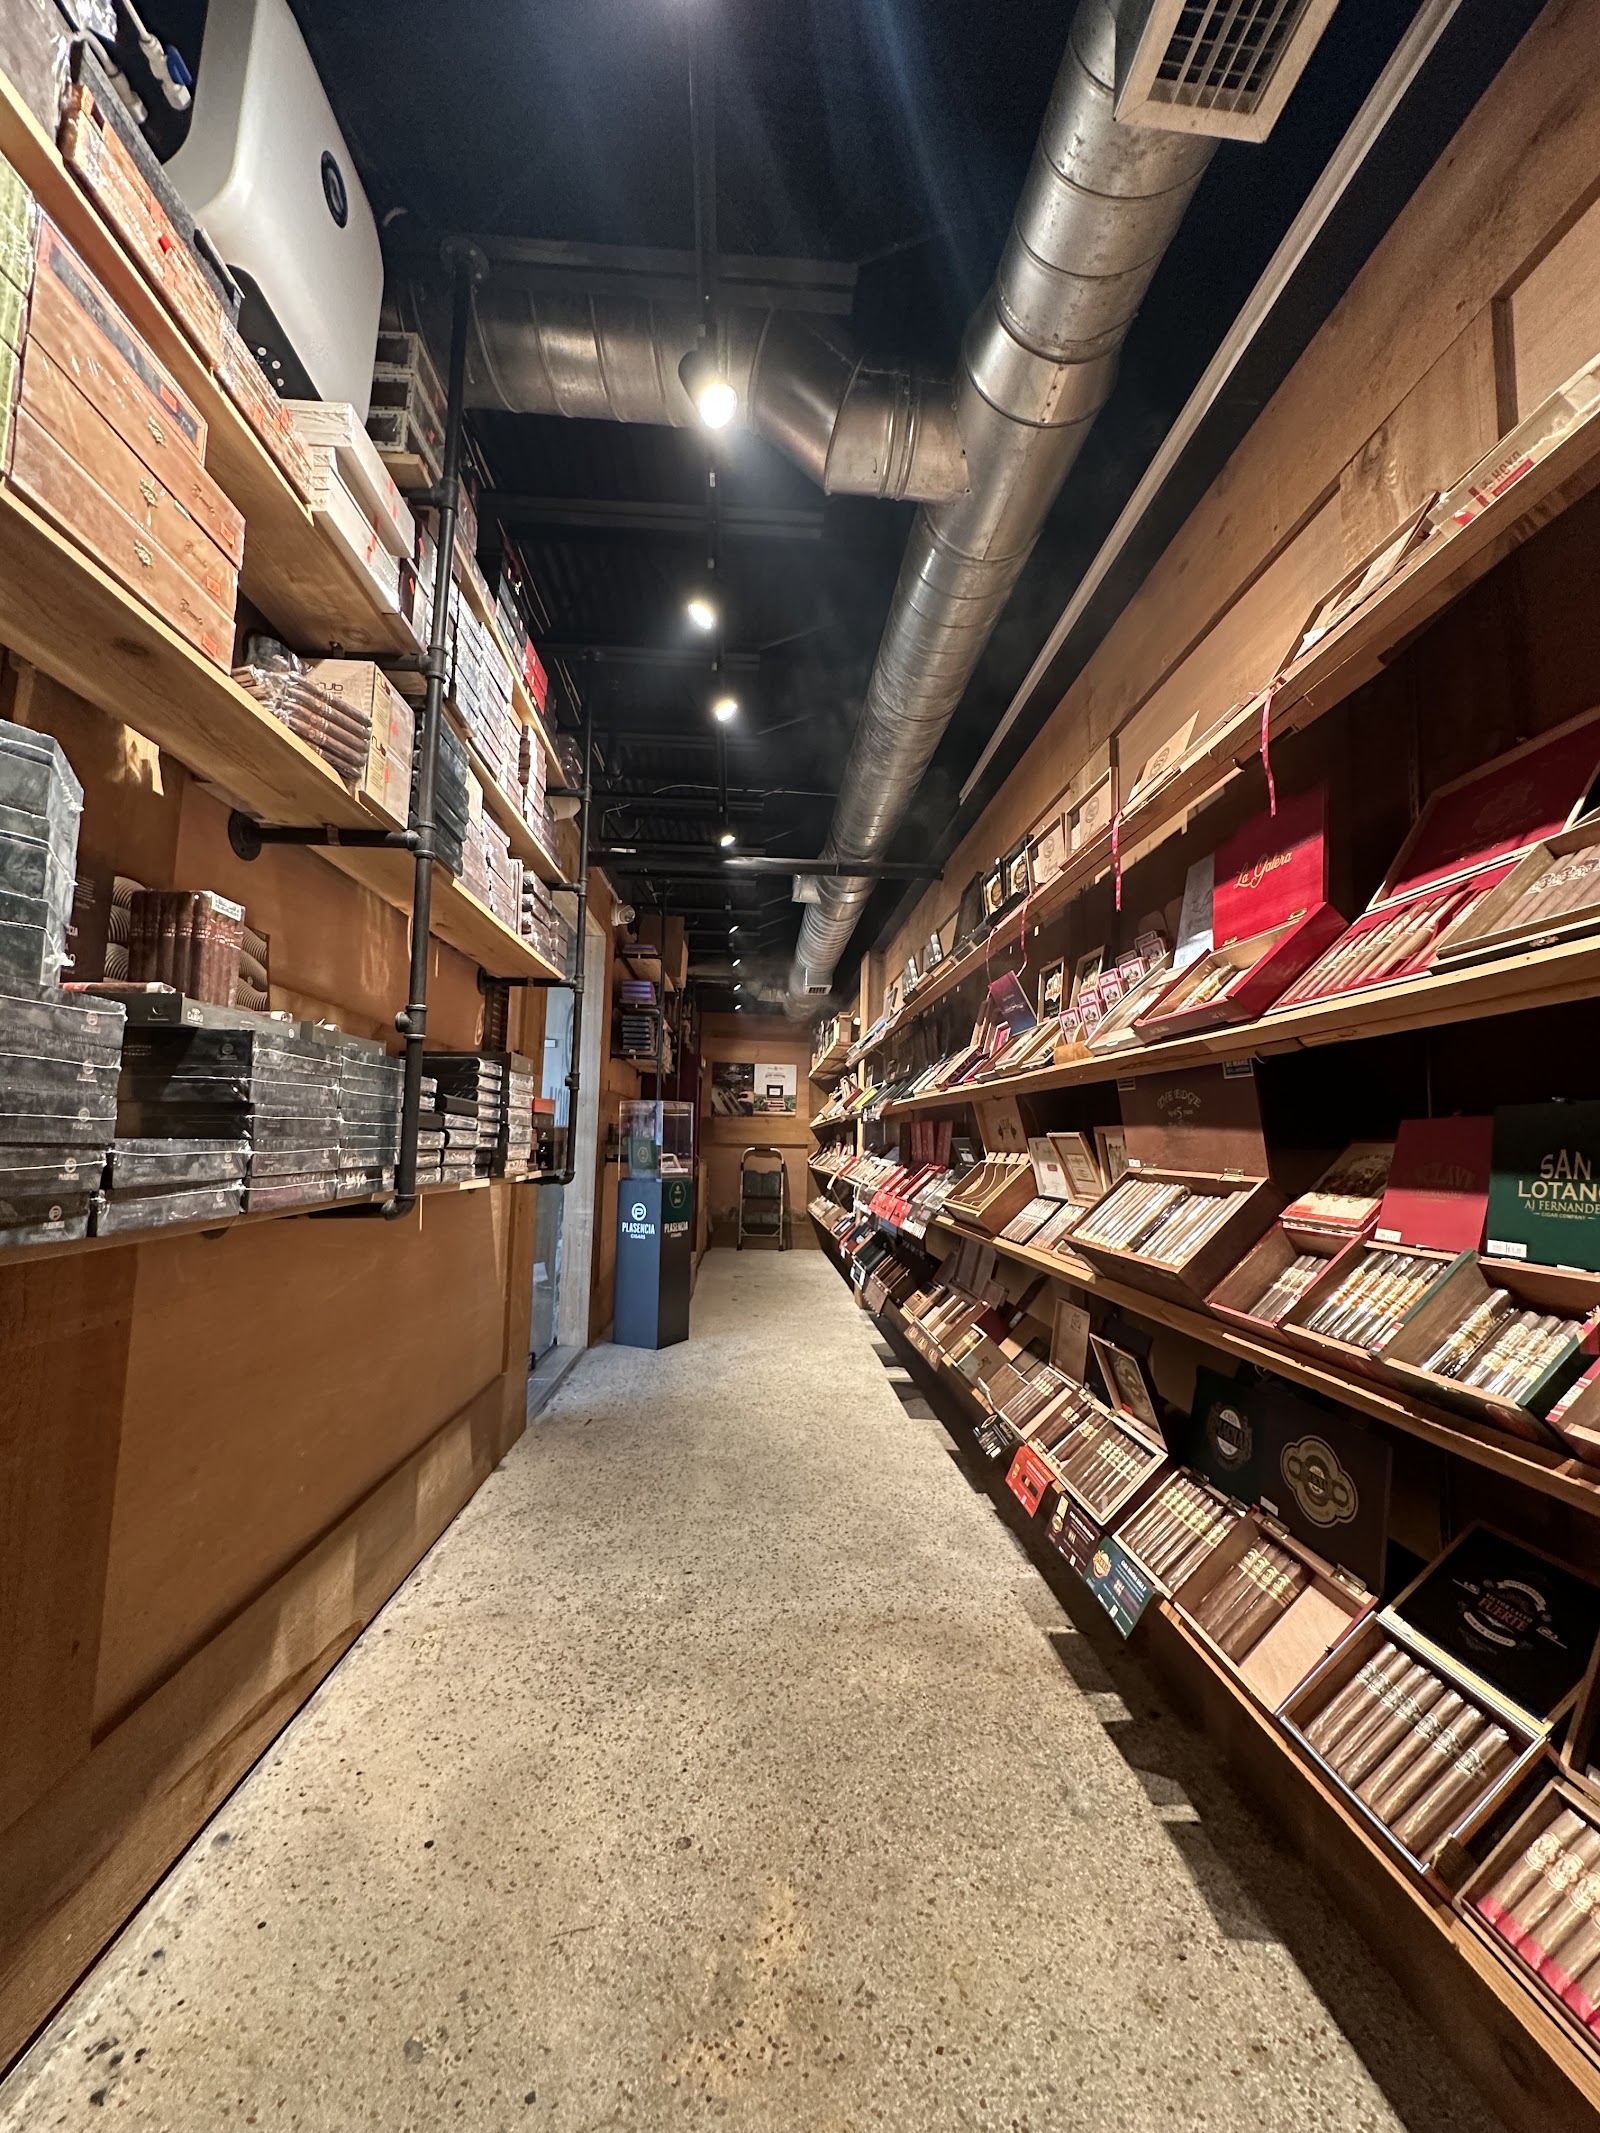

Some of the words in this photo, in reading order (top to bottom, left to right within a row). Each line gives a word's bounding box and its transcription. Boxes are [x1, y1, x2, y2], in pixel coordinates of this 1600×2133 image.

[1233, 862, 1252, 889] La
[1173, 1088, 1203, 1108] EDGE
[1540, 1148, 1592, 1181] SAN
[1518, 1180, 1600, 1202] LOTAN
[1524, 1199, 1536, 1212] AJ
[622, 1222, 655, 1235] PLASENCIA
[664, 1221, 688, 1233] PLASENCIA
[1478, 1597, 1529, 1633] FUERTE
